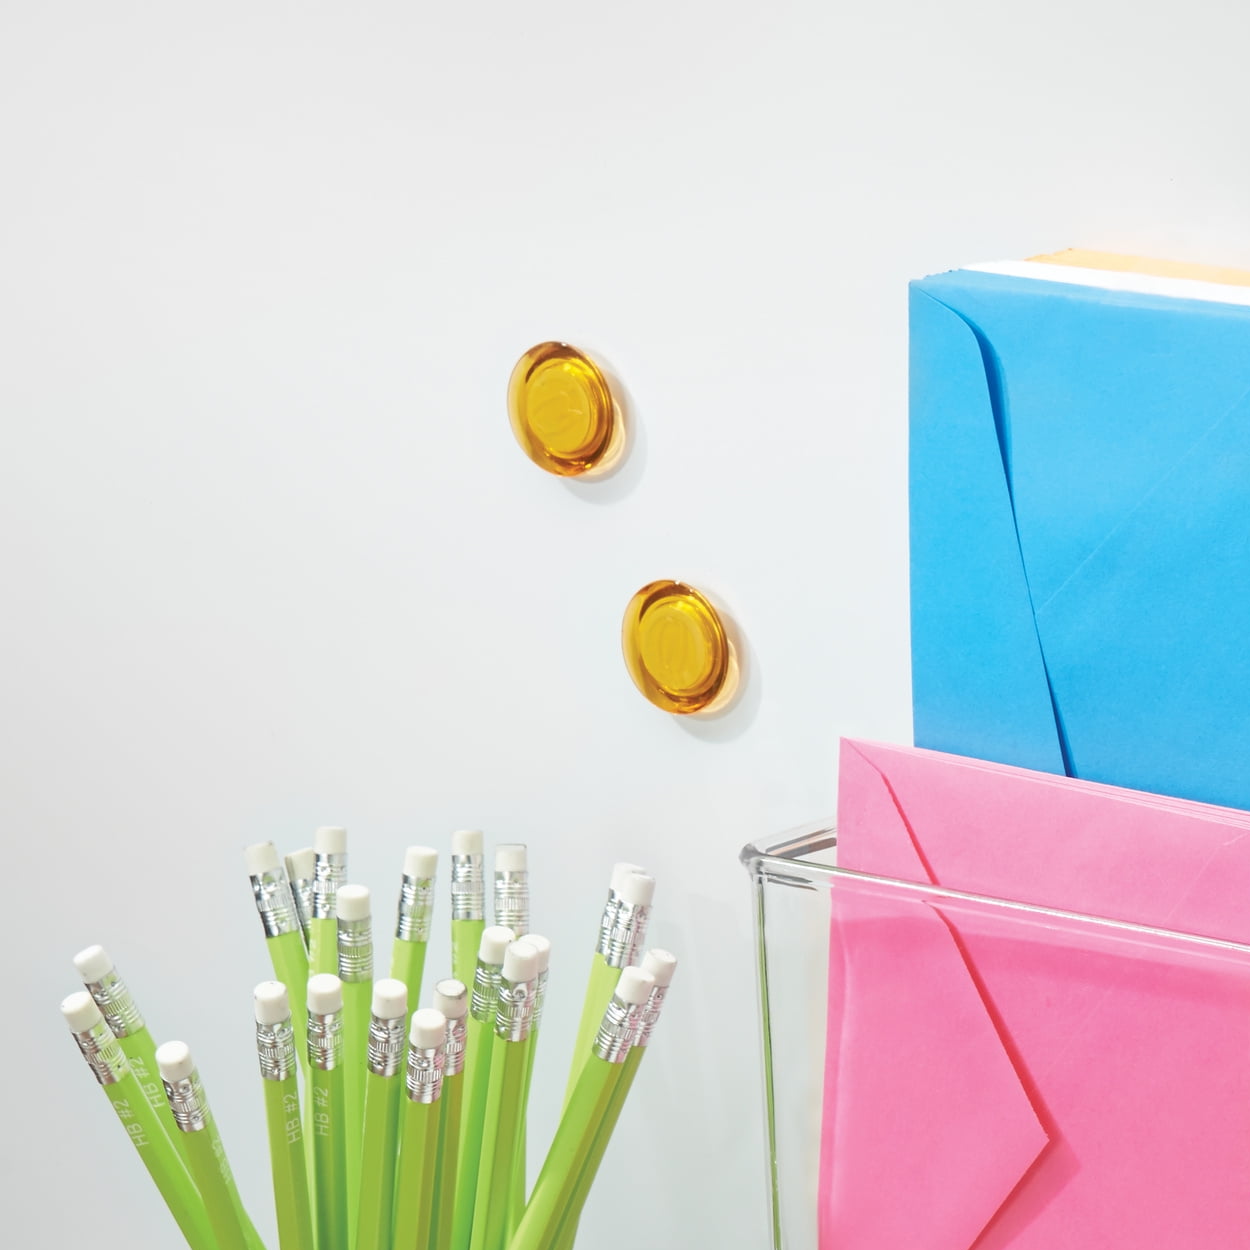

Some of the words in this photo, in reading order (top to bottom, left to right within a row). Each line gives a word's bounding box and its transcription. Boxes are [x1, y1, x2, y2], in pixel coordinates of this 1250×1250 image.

[128, 1056, 150, 1079] #2
[143, 1082, 166, 1108] HB
[282, 1091, 298, 1113] #2
[313, 1086, 329, 1107] #2
[113, 1099, 135, 1119] #2
[127, 1123, 149, 1147] HB
[286, 1118, 301, 1144] HB
[314, 1112, 330, 1136] HB
